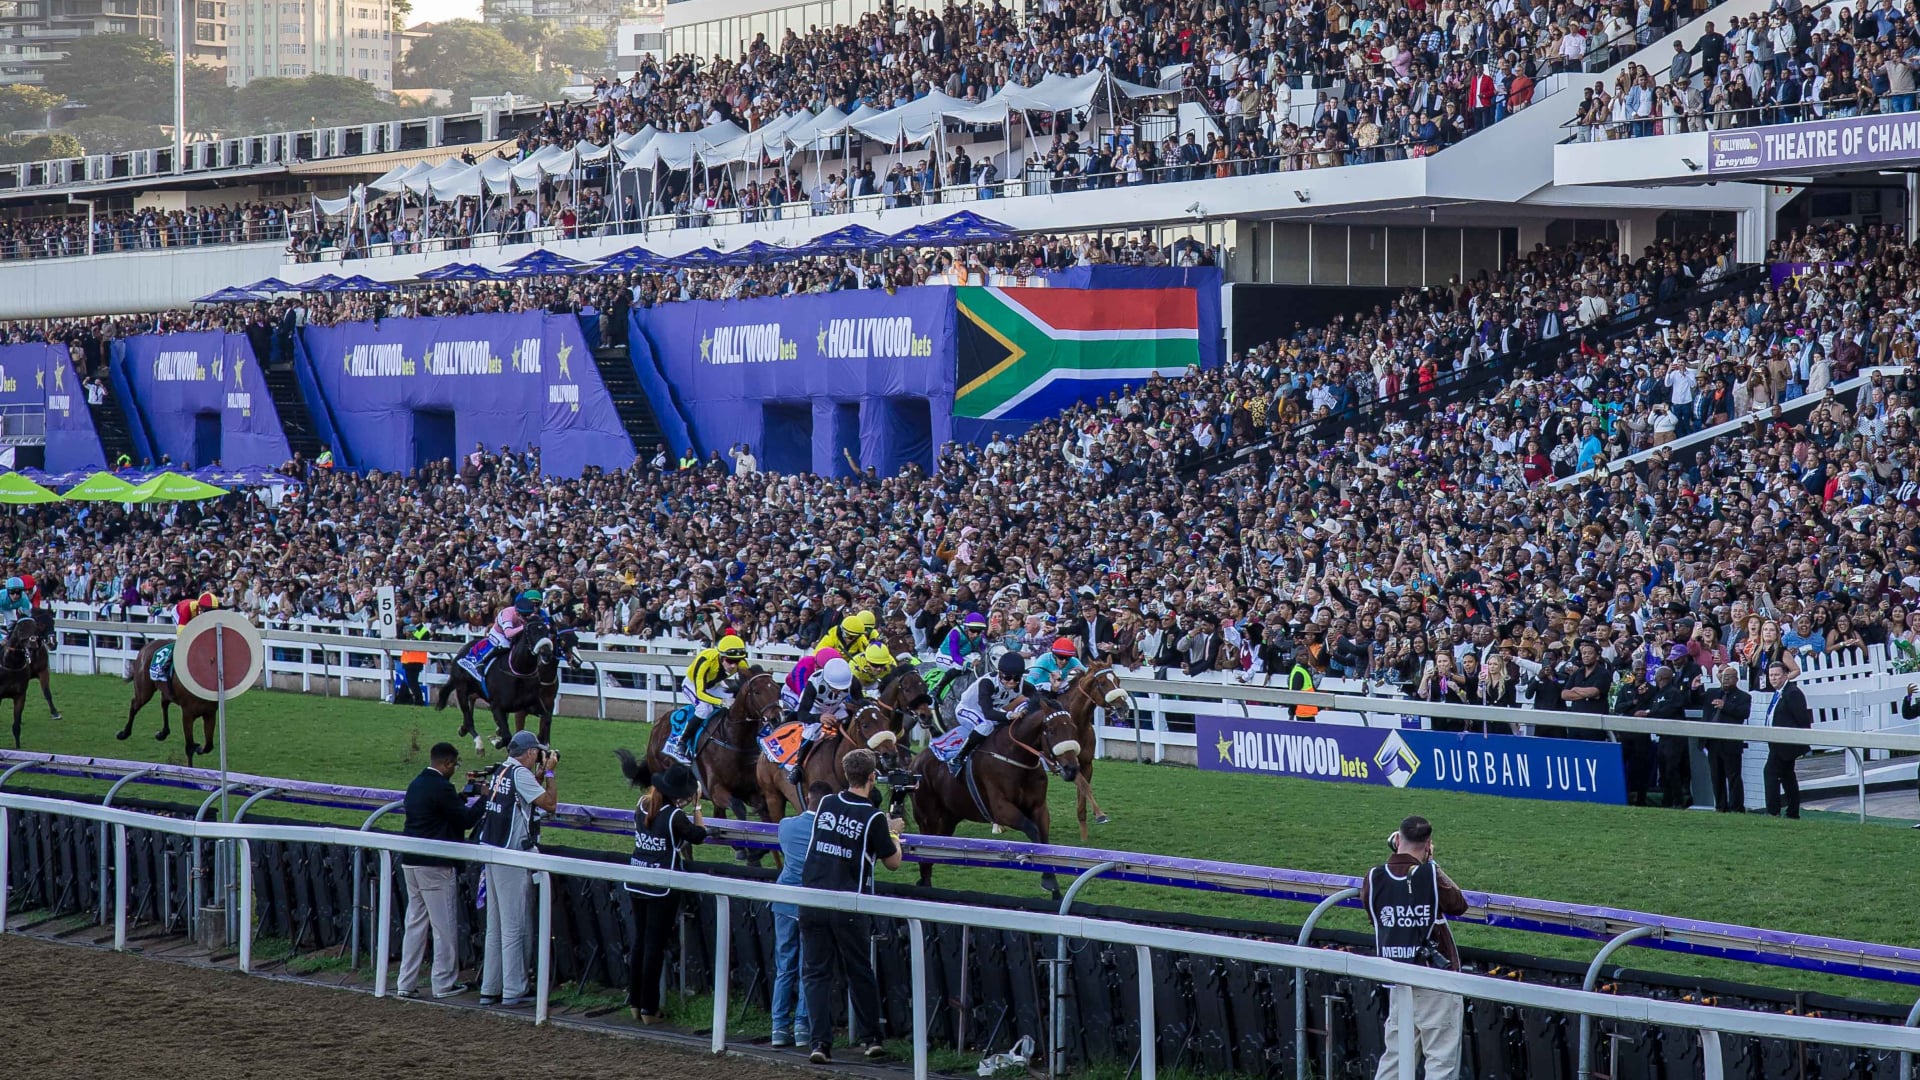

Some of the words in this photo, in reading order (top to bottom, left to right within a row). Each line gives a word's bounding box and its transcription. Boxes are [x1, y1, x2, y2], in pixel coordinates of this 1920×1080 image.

[1765, 130, 1838, 161] THEATRE
[1841, 126, 1863, 155] OF
[1867, 121, 1920, 153] CHAM
[1713, 153, 1759, 167] Greyville
[712, 322, 797, 365] HOLLYWOODbets
[828, 316, 932, 359] HOLLYWOODbets
[352, 343, 415, 377] HOLLYWOODbets
[432, 340, 502, 375] HOLLYWOODbets
[521, 338, 541, 373] HOL
[549, 385, 579, 402] HOLLYWOOD
[1233, 730, 1368, 779] HOLLYWOODbets
[1433, 748, 1530, 787] DURBAN
[1546, 755, 1597, 793] JULY
[836, 825, 861, 840] COAST
[838, 814, 865, 833] RACE
[640, 833, 666, 847] RACE
[641, 842, 666, 851] COAST
[1396, 904, 1431, 917] RACE
[1397, 916, 1431, 927] COAST
